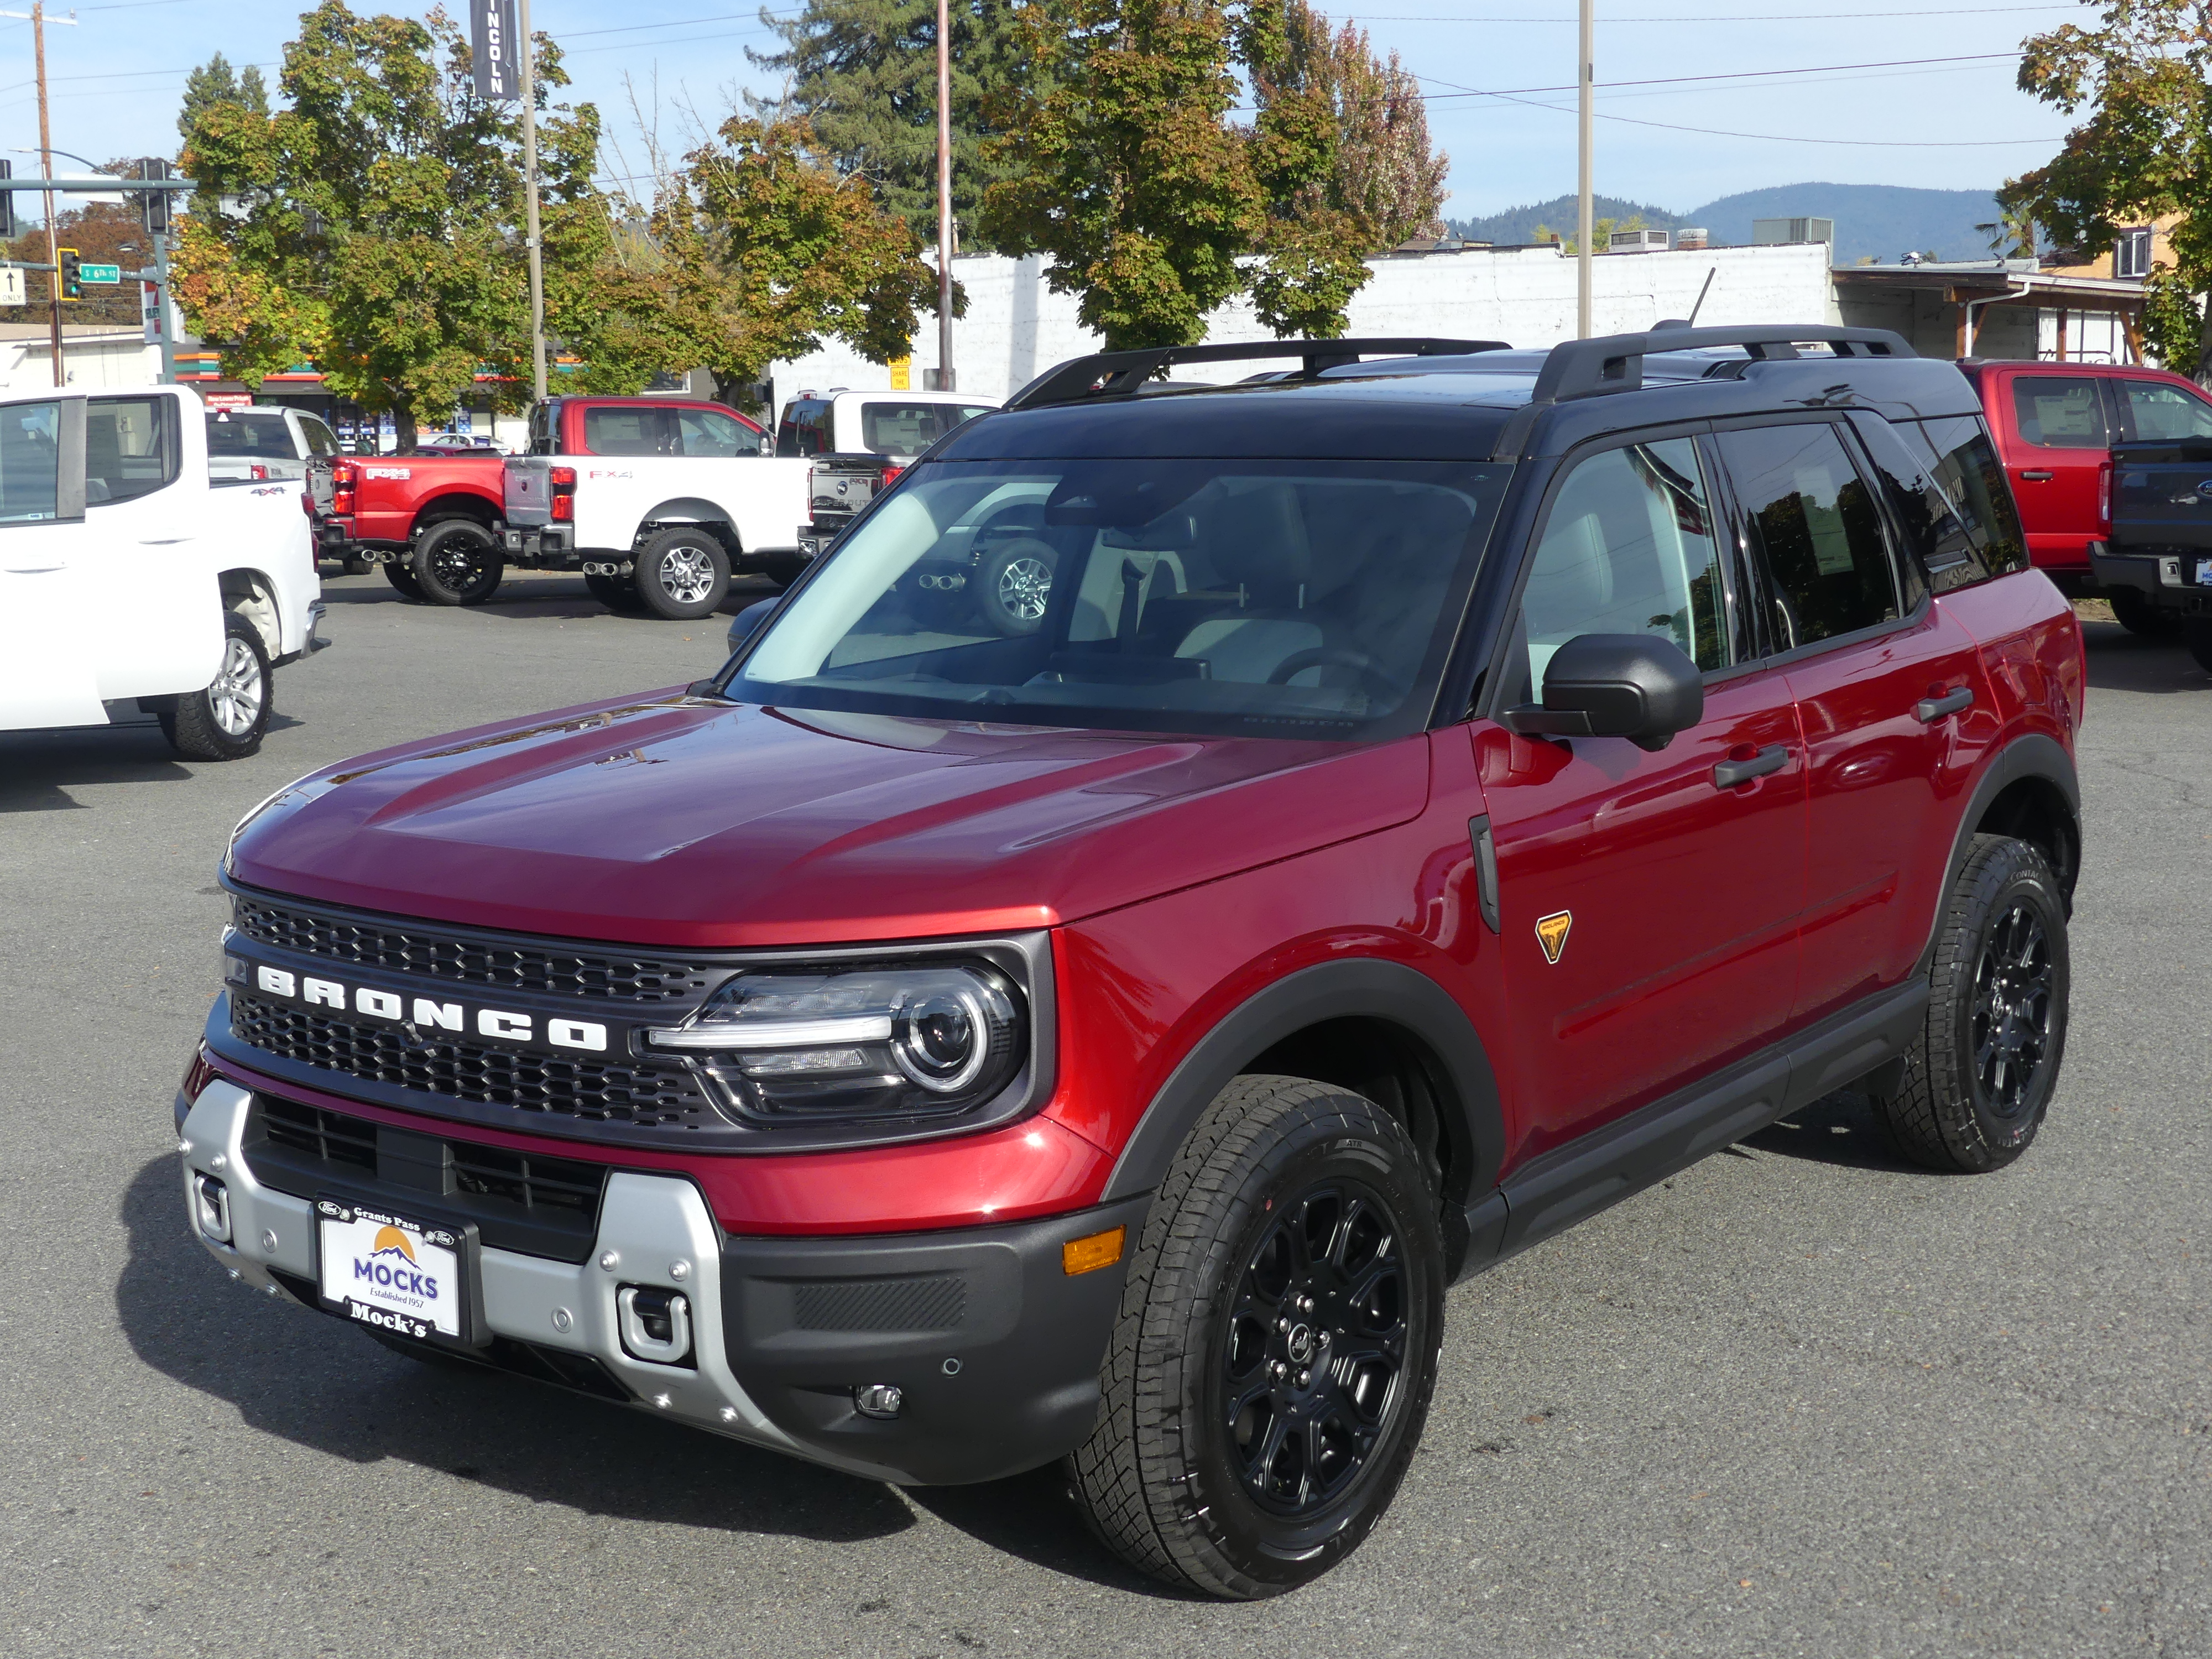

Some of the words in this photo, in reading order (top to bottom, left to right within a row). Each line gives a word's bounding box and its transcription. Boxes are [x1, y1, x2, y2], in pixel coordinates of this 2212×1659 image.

[367, 468, 410, 479] FX4
[1542, 919, 1565, 931] BADLANDS
[258, 966, 607, 1051] BRONCO
[353, 1207, 393, 1224] Grants
[393, 1217, 421, 1232] Pass
[353, 1256, 440, 1300] MOCKS
[370, 1287, 408, 1304] Established
[408, 1297, 424, 1308] 1957
[350, 1301, 427, 1338] Mock's
